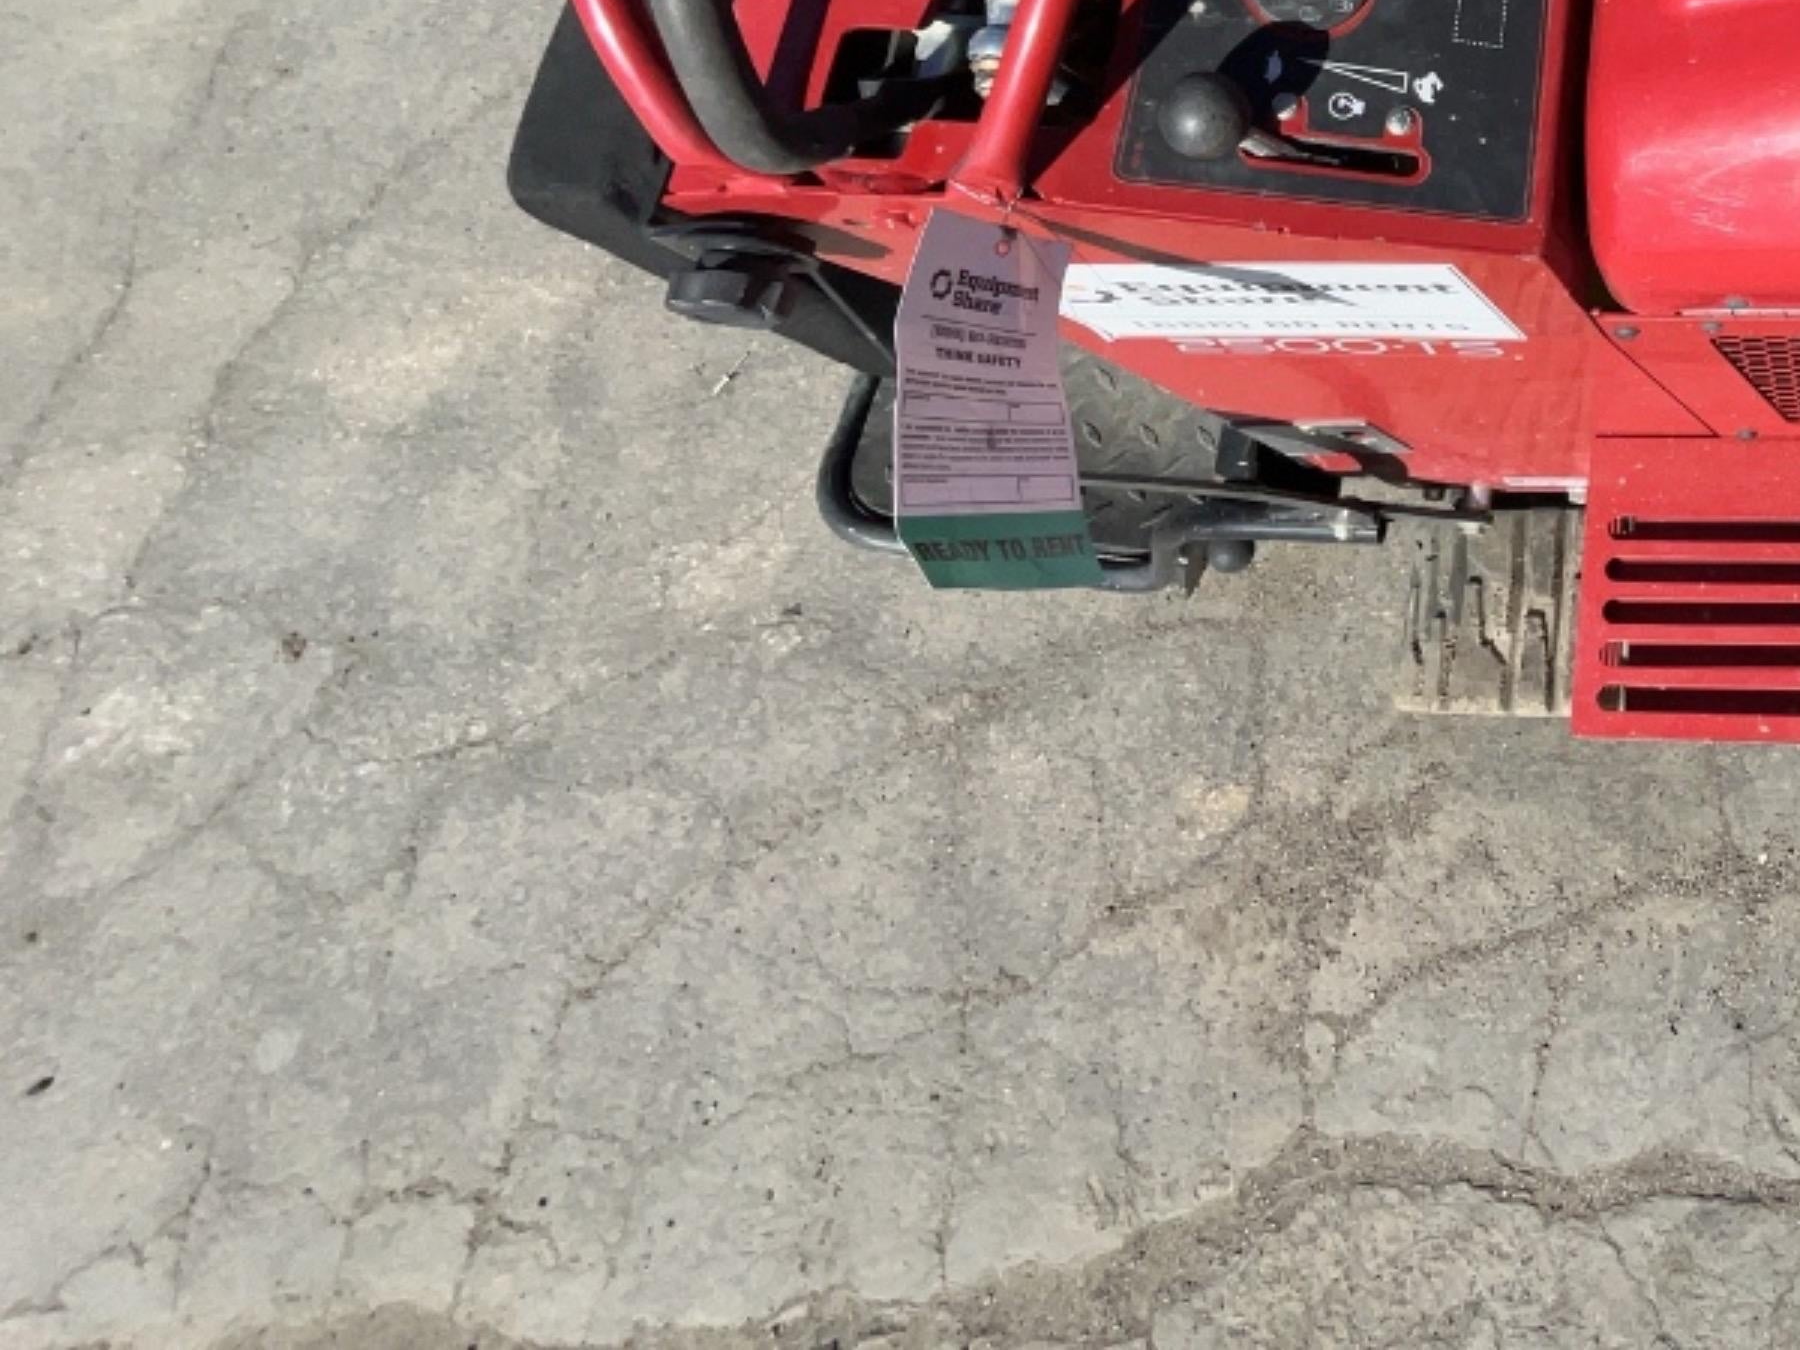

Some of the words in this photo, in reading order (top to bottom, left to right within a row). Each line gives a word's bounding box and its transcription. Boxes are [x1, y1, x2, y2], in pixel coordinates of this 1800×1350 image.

[956, 269, 1039, 303] Equipment
[952, 290, 1004, 315] Share
[977, 353, 1022, 369] SAFETY
[915, 538, 990, 562] READY
[995, 538, 1026, 561] TO
[1031, 534, 1086, 559] RENT
